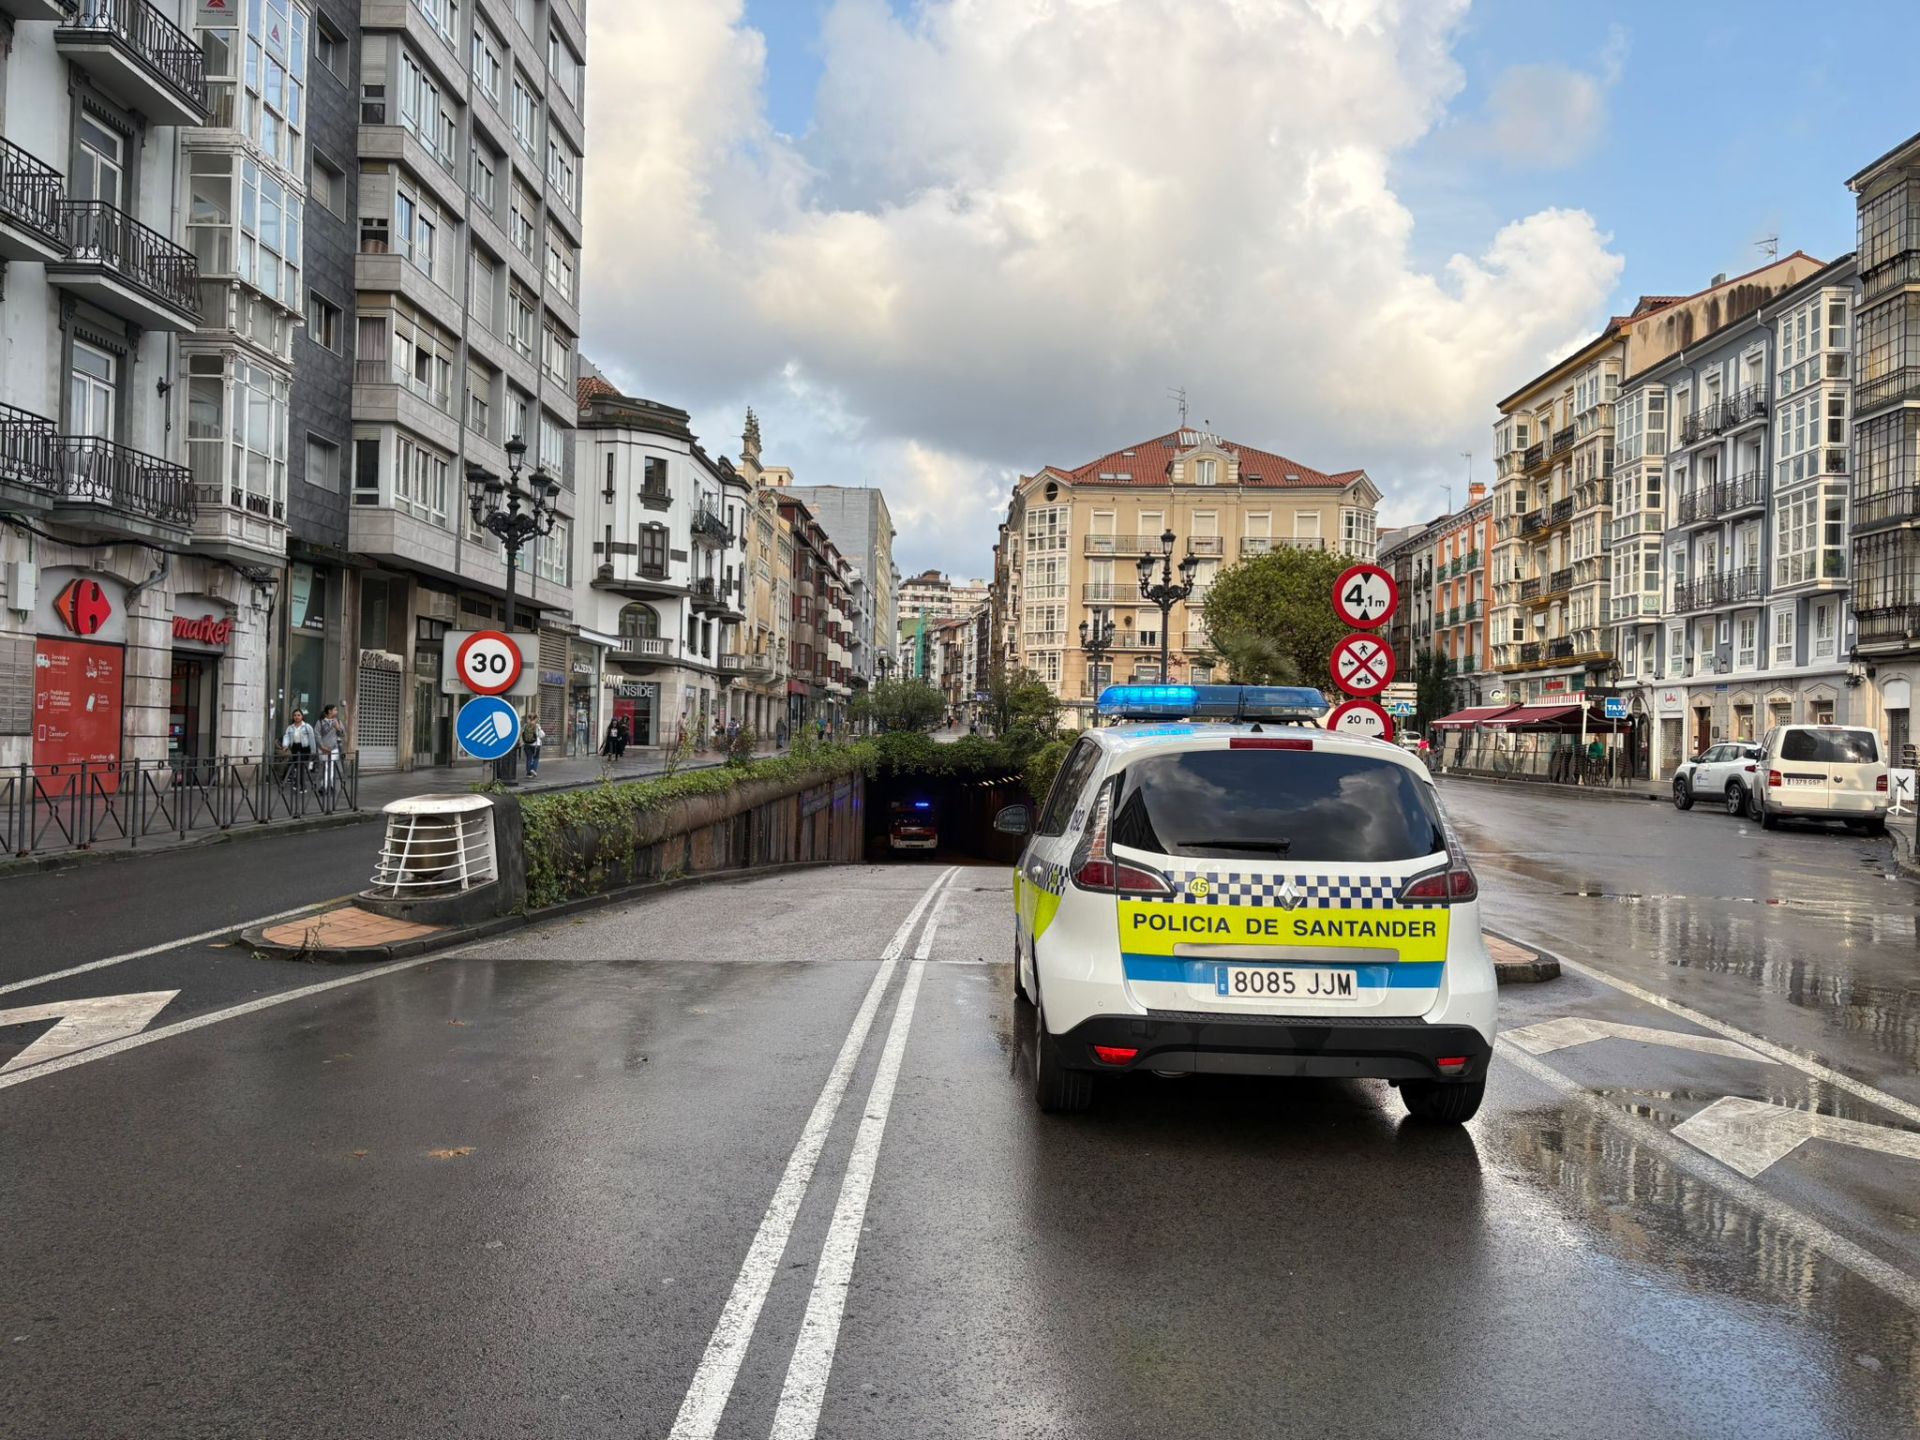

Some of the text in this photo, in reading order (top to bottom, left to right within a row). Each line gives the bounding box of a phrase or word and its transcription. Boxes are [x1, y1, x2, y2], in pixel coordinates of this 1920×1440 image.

[173, 614, 234, 645] market
[472, 653, 506, 674] 30
[619, 686, 654, 697] INSIDE
[1347, 715, 1361, 724] 20
[1191, 881, 1207, 893] 45
[1133, 912, 1436, 938] POLICIA DE SANTANDER
[1235, 971, 1296, 993] 8085
[1307, 972, 1352, 996] JJM
